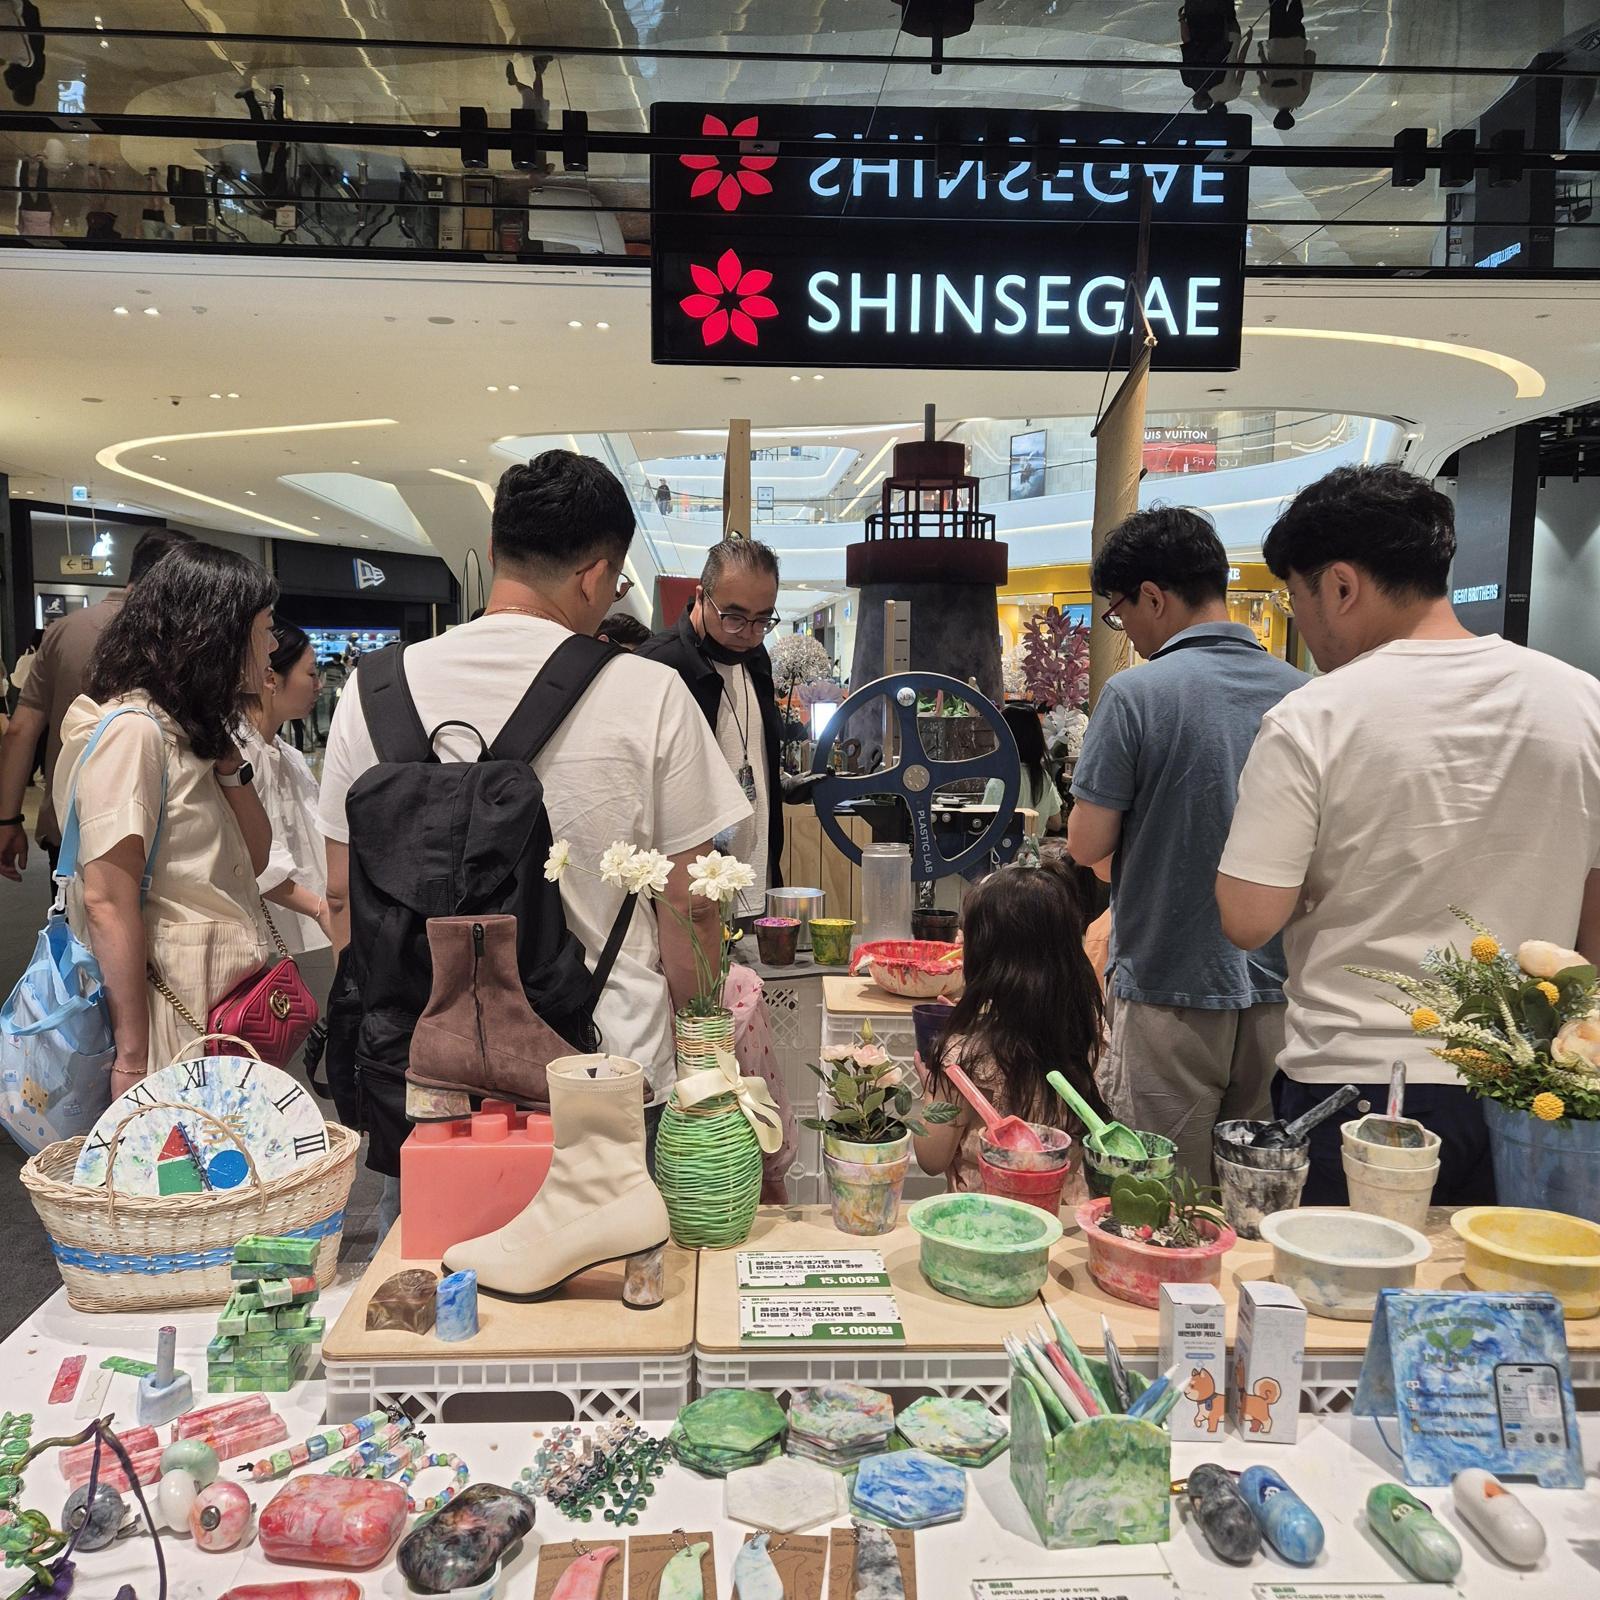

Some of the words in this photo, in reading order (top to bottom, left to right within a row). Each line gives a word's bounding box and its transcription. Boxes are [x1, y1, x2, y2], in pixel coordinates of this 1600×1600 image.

[807, 270, 1221, 336] SHINSEGAE
[1165, 430, 1208, 440] VUITTON
[1468, 584, 1498, 602] BROTHERS
[916, 810, 931, 852] PLASTIC
[922, 854, 933, 873] LAB
[828, 1326, 894, 1335] 12,000원
